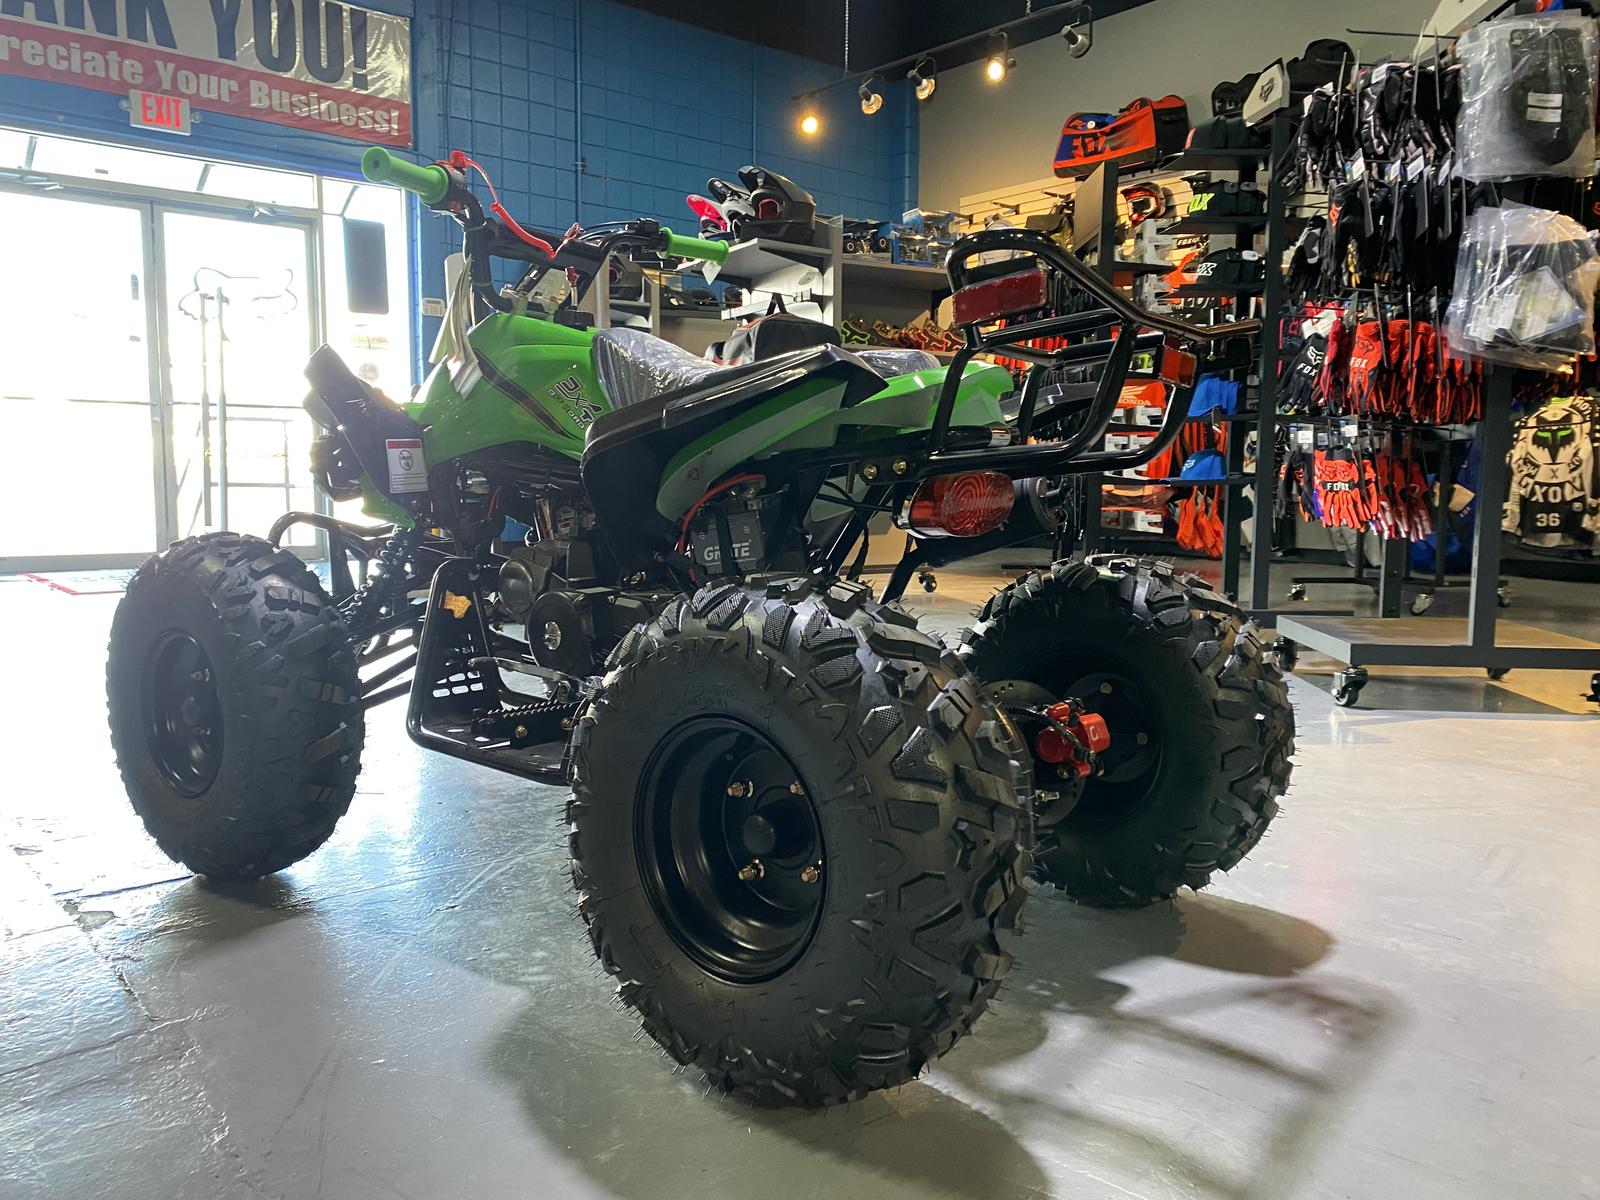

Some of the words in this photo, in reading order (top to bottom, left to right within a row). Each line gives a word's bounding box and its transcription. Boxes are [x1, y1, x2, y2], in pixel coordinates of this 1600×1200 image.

[0, 34, 143, 85] reciate
[155, 60, 239, 103] Your
[250, 79, 399, 136] Business!
[142, 93, 182, 128] EXIT
[1350, 357, 1368, 368] FOX
[1297, 363, 1318, 376] FOX
[1536, 513, 1560, 526] 36
